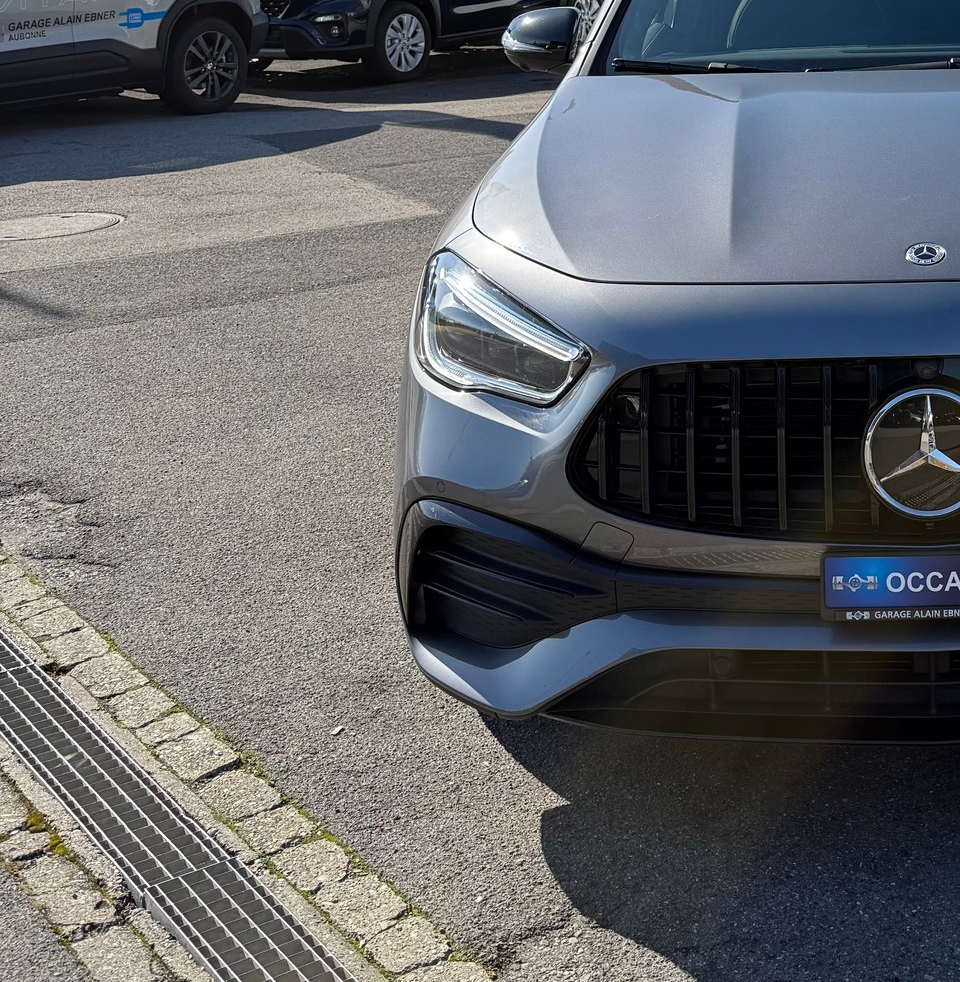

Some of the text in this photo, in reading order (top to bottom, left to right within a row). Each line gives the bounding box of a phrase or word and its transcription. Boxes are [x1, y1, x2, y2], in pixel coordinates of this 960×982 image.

[8, 18, 51, 32] GARAGE
[53, 14, 82, 26] ALAIN
[84, 10, 116, 22] EBNER
[8, 30, 46, 42] AUBONNE
[874, 610, 911, 619] GARAGE
[913, 609, 941, 618] ALAIN
